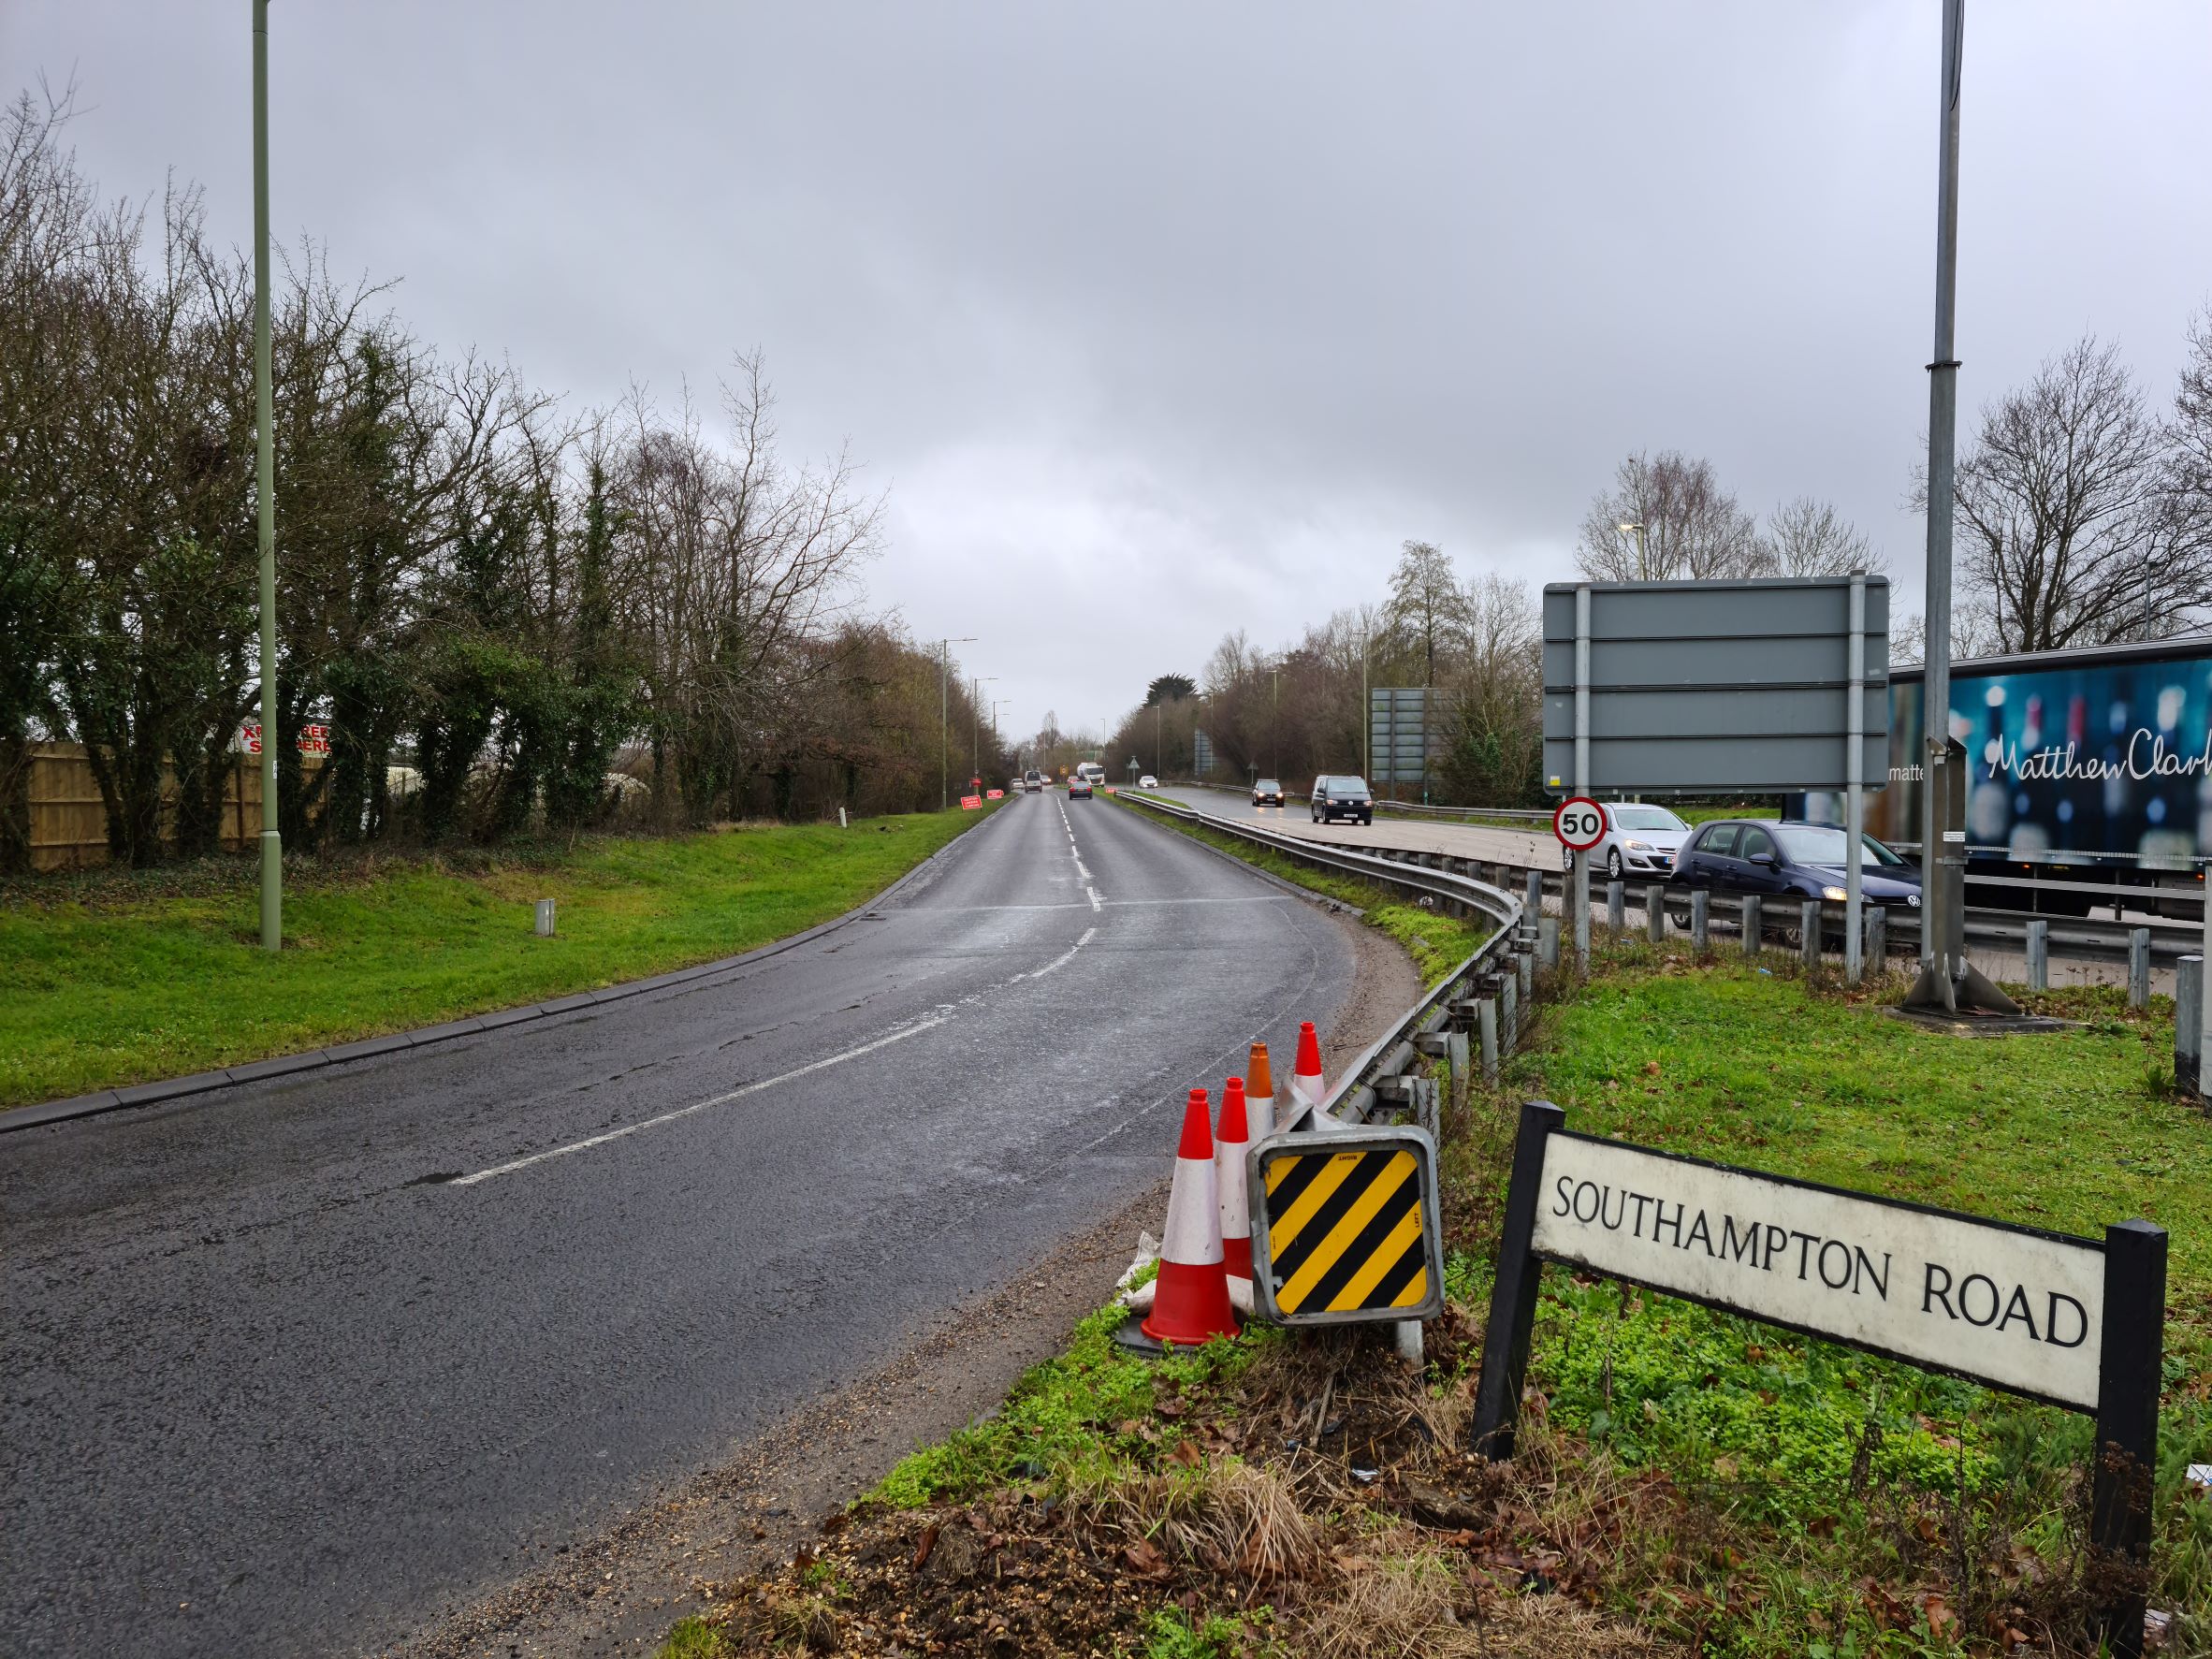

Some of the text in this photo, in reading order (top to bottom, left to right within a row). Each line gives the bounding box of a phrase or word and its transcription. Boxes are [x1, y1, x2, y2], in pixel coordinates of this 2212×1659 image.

[1988, 733, 2128, 780] Matthew
[1563, 813, 1599, 836] 50
[1552, 1175, 2088, 1348] SOUTHAMPTON ROAD
